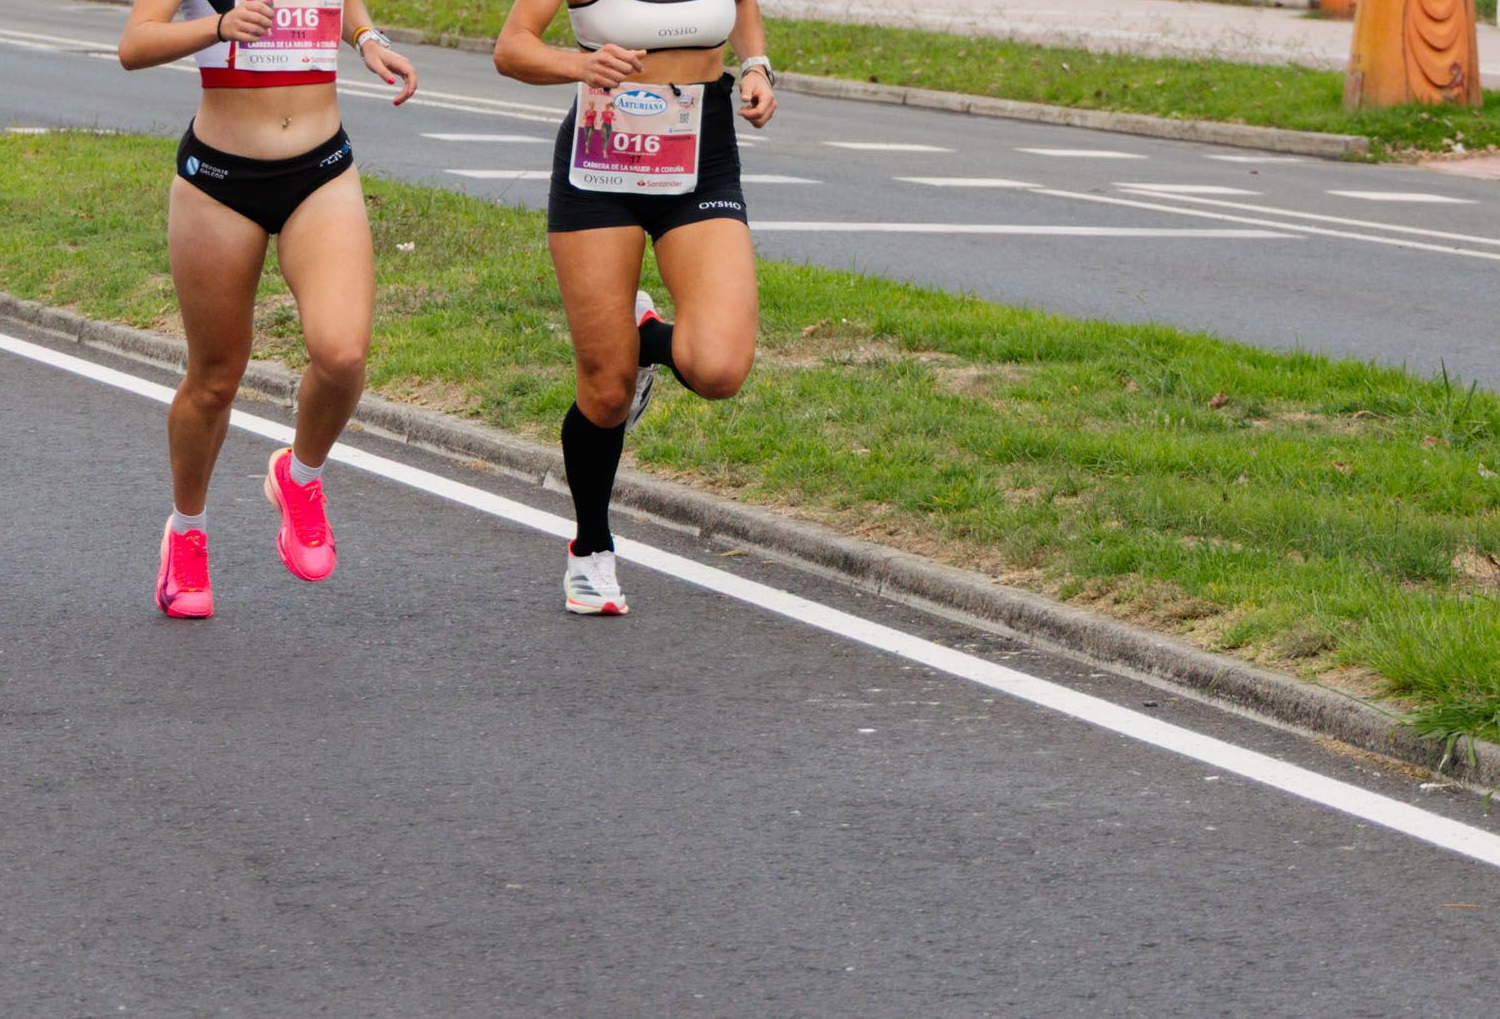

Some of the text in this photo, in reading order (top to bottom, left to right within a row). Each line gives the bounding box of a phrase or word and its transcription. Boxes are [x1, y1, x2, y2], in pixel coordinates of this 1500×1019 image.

[276, 8, 319, 28] 016
[658, 26, 697, 37] OYSHO
[249, 54, 288, 64] OYSHO
[618, 98, 664, 110] ASTURIANA
[613, 133, 661, 153] 016
[583, 161, 610, 170] CARRERA
[584, 174, 623, 185] OYSHO
[699, 200, 741, 211] OYSHO
